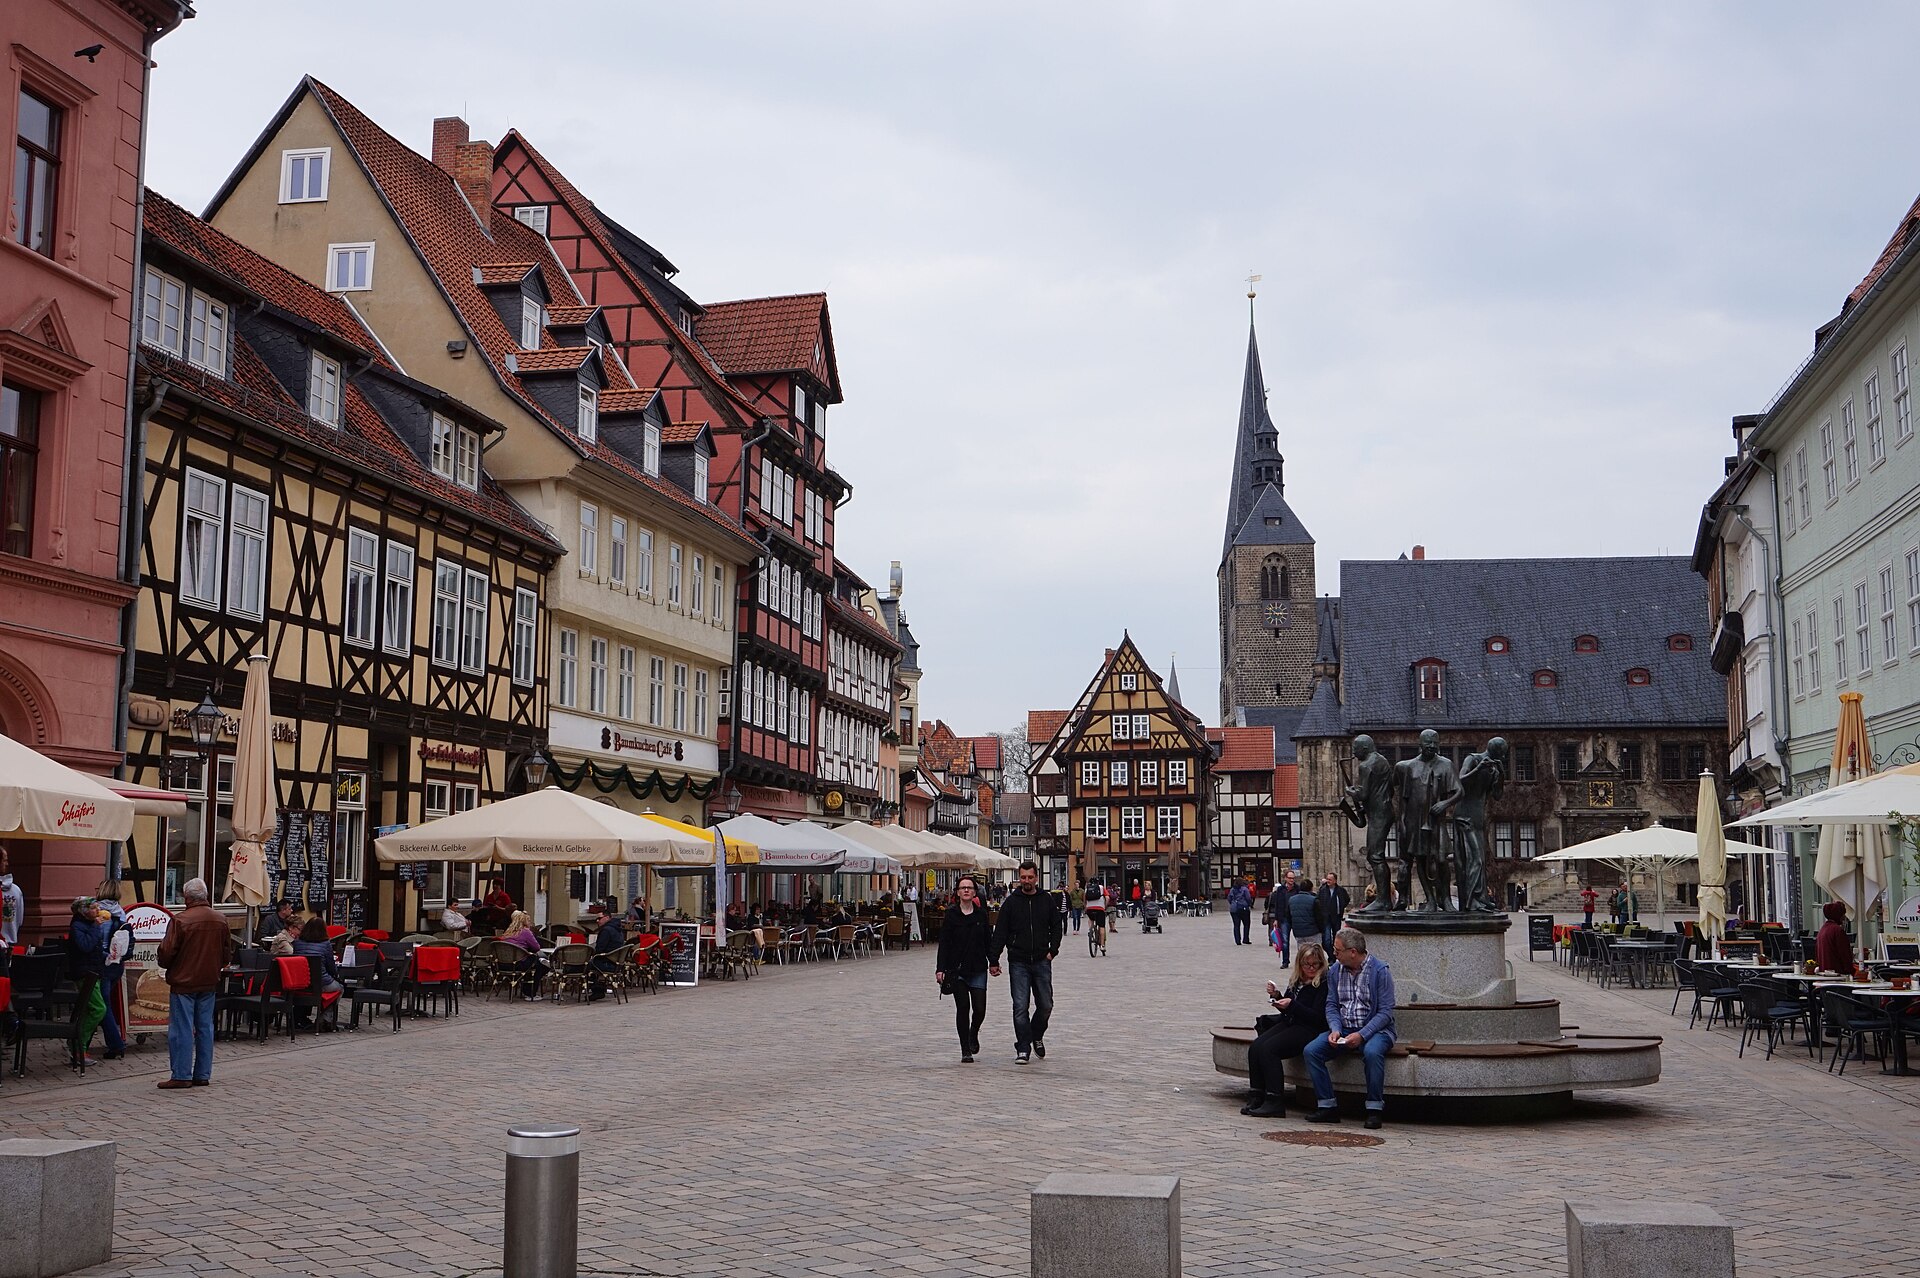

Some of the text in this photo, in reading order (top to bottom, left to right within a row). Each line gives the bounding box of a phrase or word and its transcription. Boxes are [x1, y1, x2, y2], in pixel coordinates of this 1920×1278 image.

[614, 733, 672, 757] Baumkuchen Café
[351, 781, 360, 796] EIS
[58, 800, 95, 826] Schäfer's
[400, 844, 429, 853] Bäckerei
[523, 844, 591, 853] Bäckerei M. Gelbke
[765, 852, 809, 860] Baumkuchen
[126, 914, 167, 930] Schäfer's
